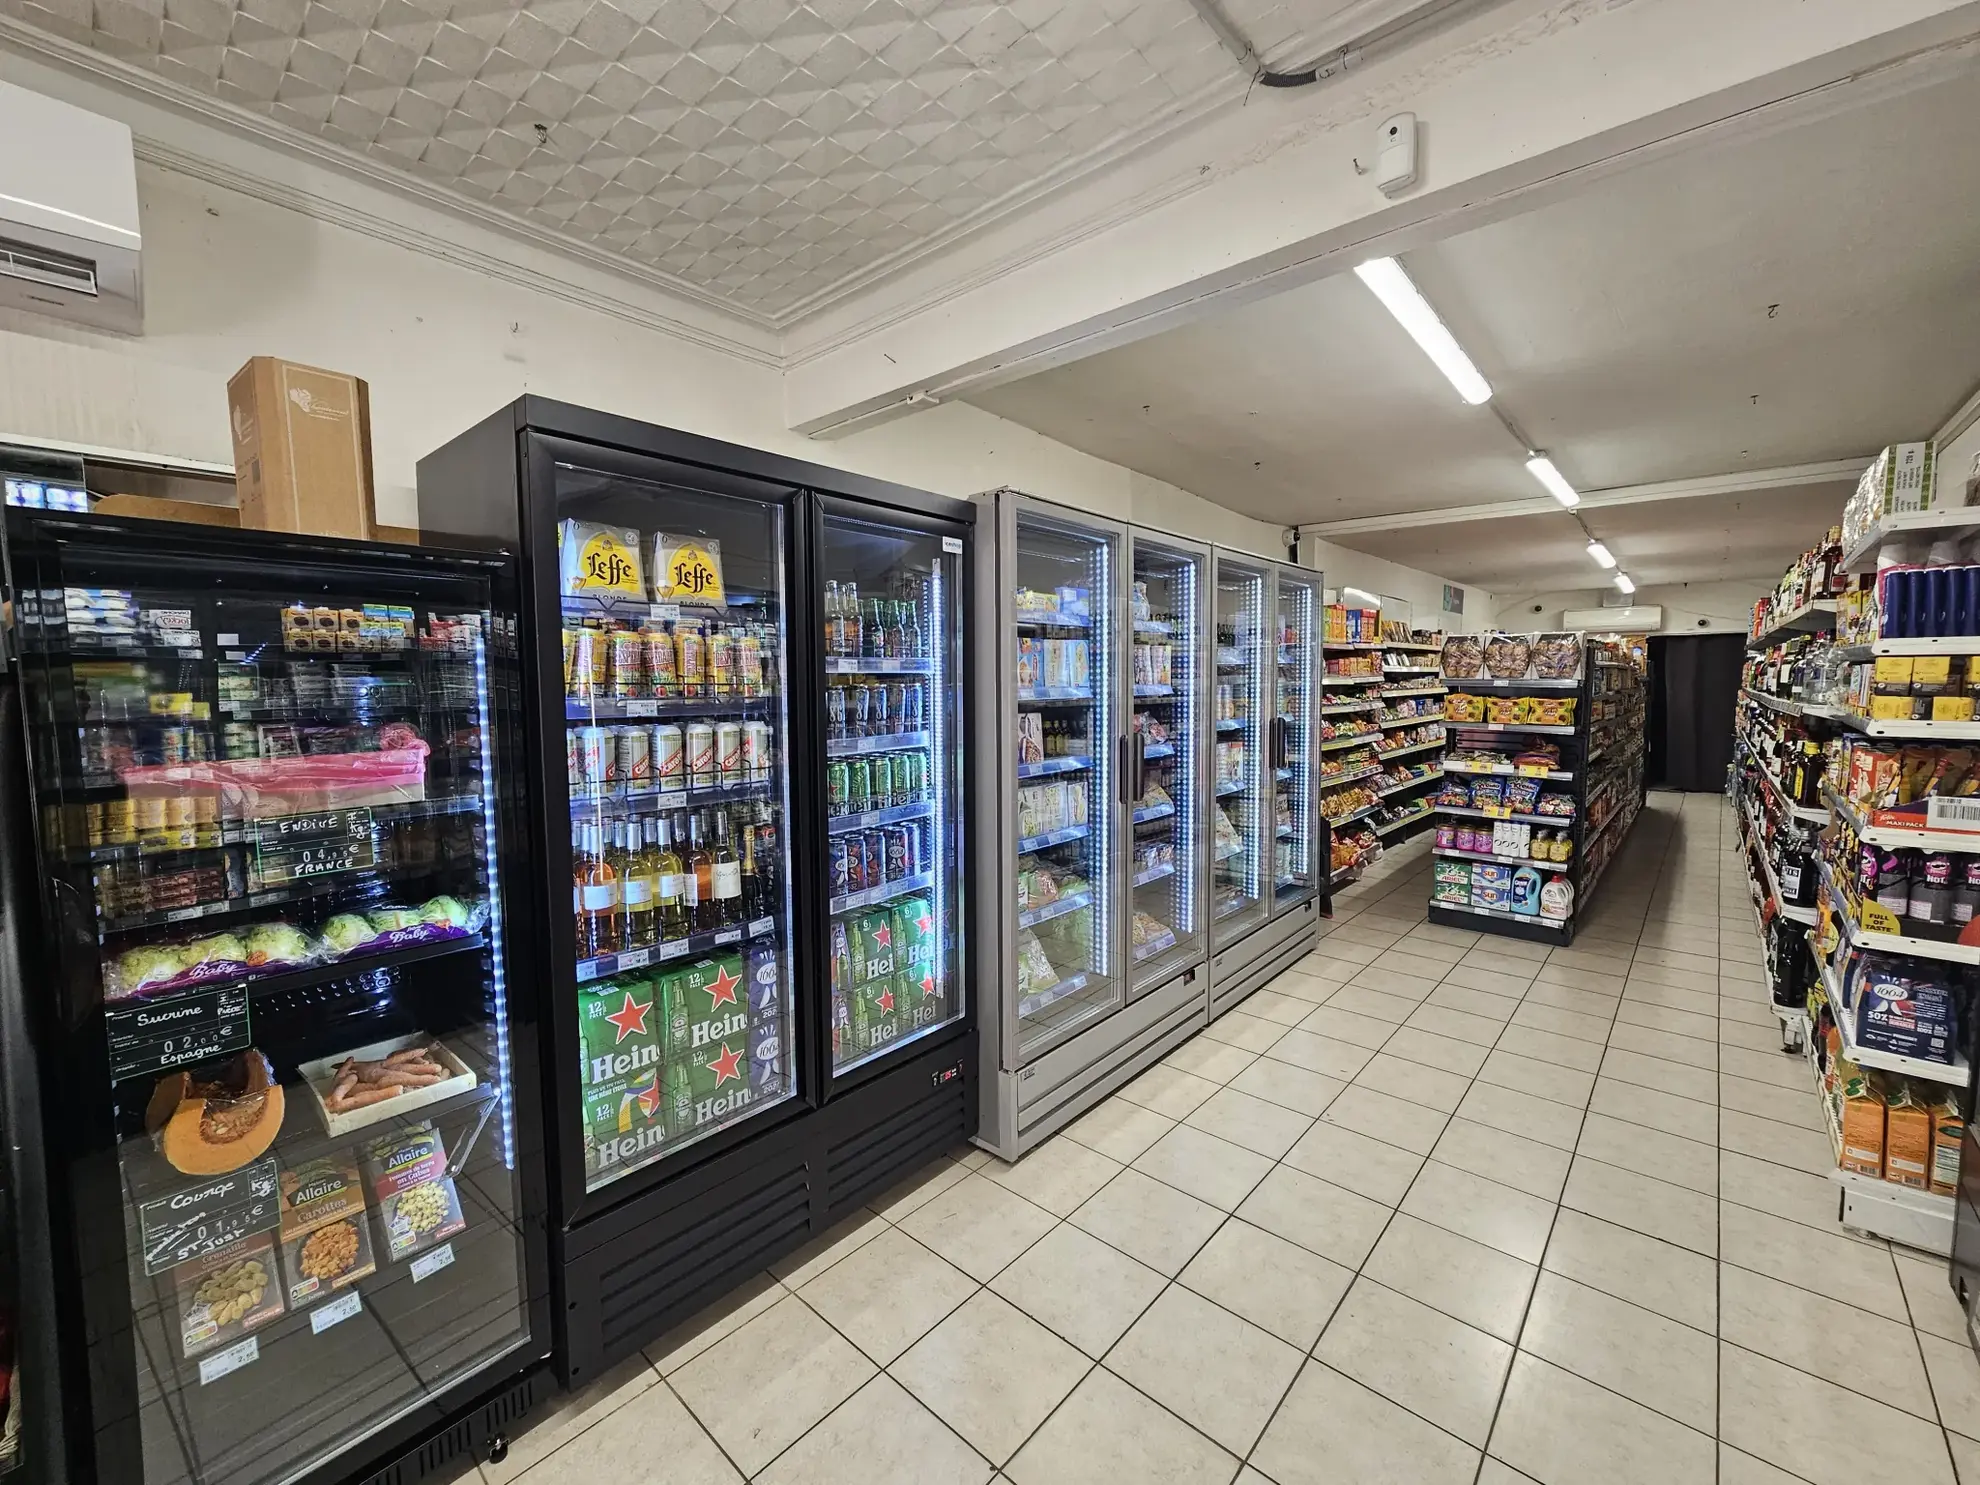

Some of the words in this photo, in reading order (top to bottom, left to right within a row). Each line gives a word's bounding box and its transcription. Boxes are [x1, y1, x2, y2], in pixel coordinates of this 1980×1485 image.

[586, 552, 632, 586] Leffe
[674, 562, 713, 594] Leffe
[295, 858, 353, 877] FRANCE
[1869, 913, 1889, 921] FULL
[389, 927, 430, 943] Baby
[190, 961, 237, 979] Baby
[688, 972, 701, 984] 12
[1876, 986, 1906, 998] 1664
[588, 1001, 602, 1014] 12
[691, 1012, 748, 1049] Hein
[160, 1044, 222, 1065] Espagne
[592, 1044, 660, 1085] Hein
[692, 1050, 704, 1062] 12
[595, 1103, 610, 1118] 12
[695, 1087, 752, 1126] Hein
[597, 1124, 665, 1169] Hein
[388, 1146, 428, 1169] Allaire
[295, 1179, 342, 1205] Allaire
[297, 1198, 348, 1223] Carottes
